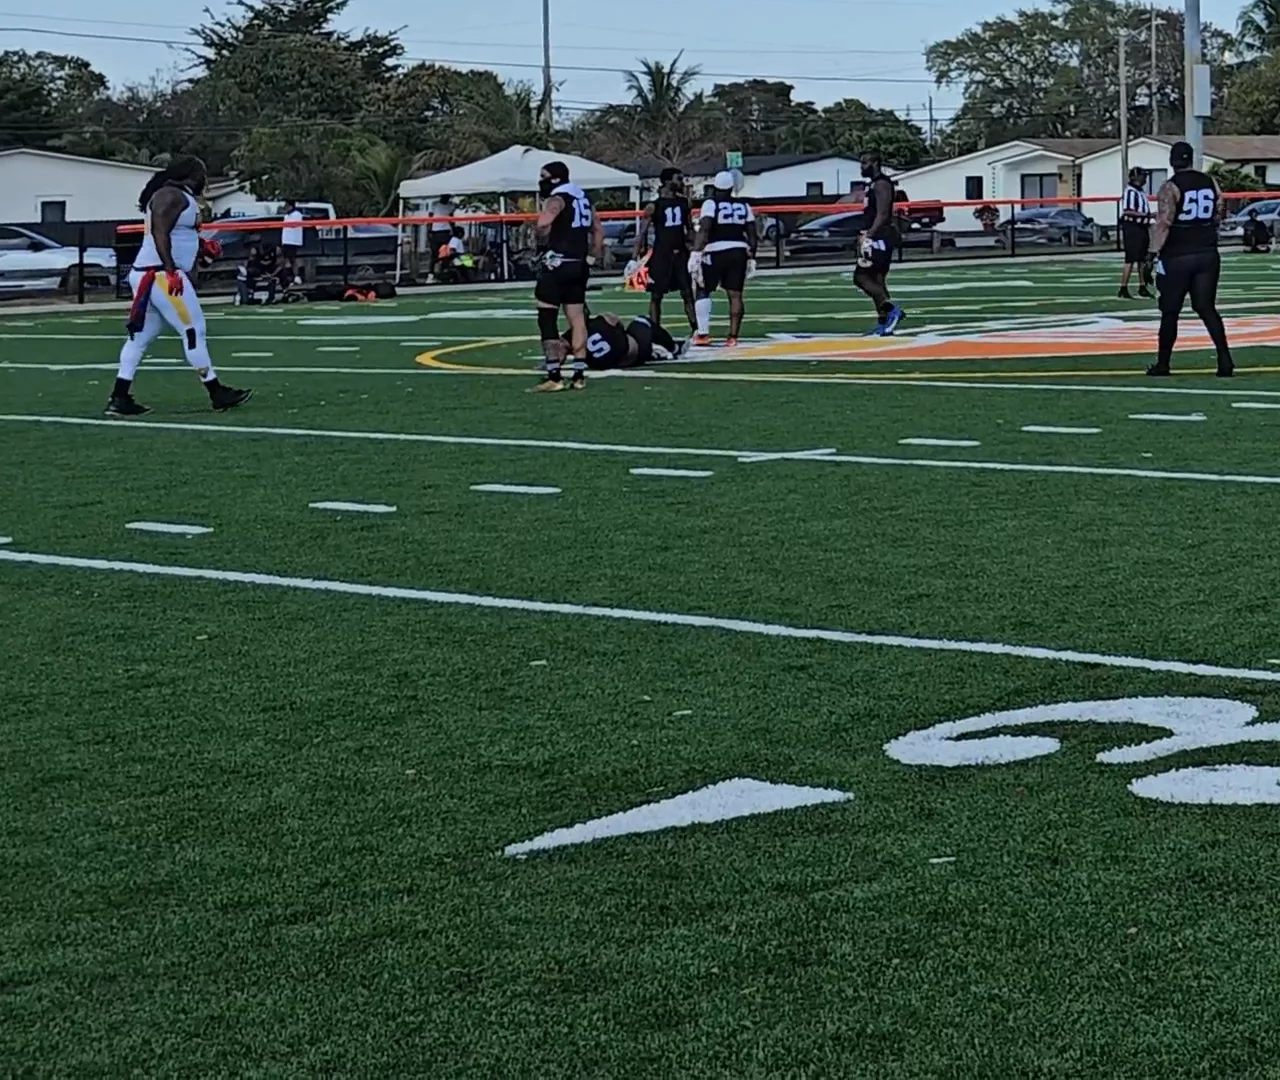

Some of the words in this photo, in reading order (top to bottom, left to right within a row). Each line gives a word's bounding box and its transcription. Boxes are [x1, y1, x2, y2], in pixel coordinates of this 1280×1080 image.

[571, 199, 593, 228] 15
[664, 206, 682, 227] 11
[717, 202, 747, 225] 22
[1178, 188, 1215, 220] 56
